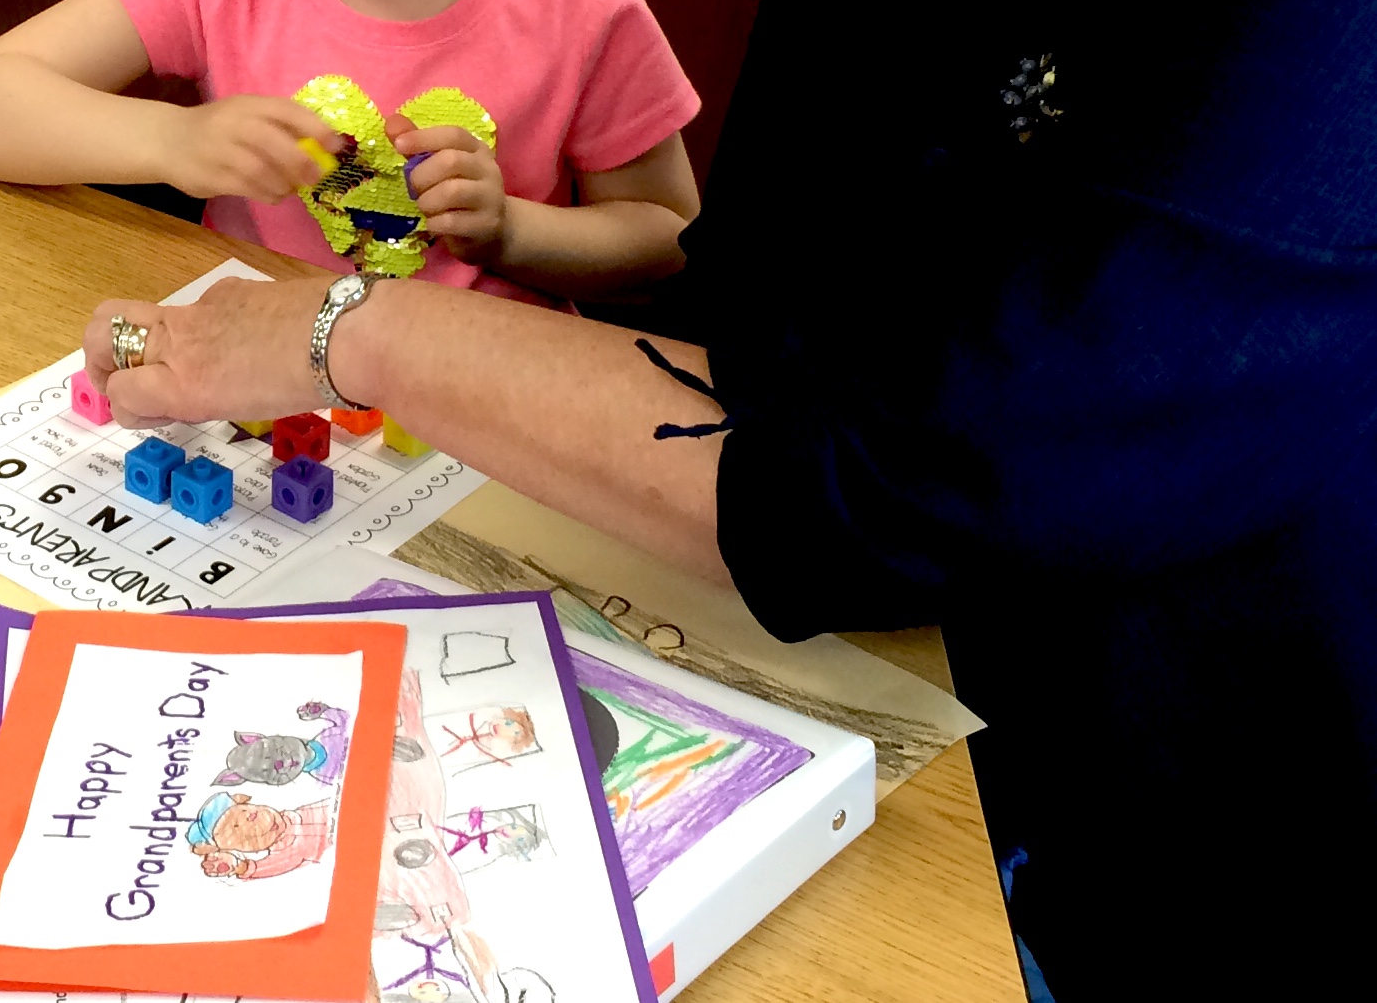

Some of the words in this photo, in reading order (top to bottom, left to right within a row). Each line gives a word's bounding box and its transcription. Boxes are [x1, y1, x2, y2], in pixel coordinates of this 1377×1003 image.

[91, 452, 125, 472] ogether
[87, 505, 134, 533] N
[199, 561, 235, 585] B
[43, 742, 133, 839] Happy
[105, 727, 201, 921] Grandparents
[158, 661, 229, 718] Day
